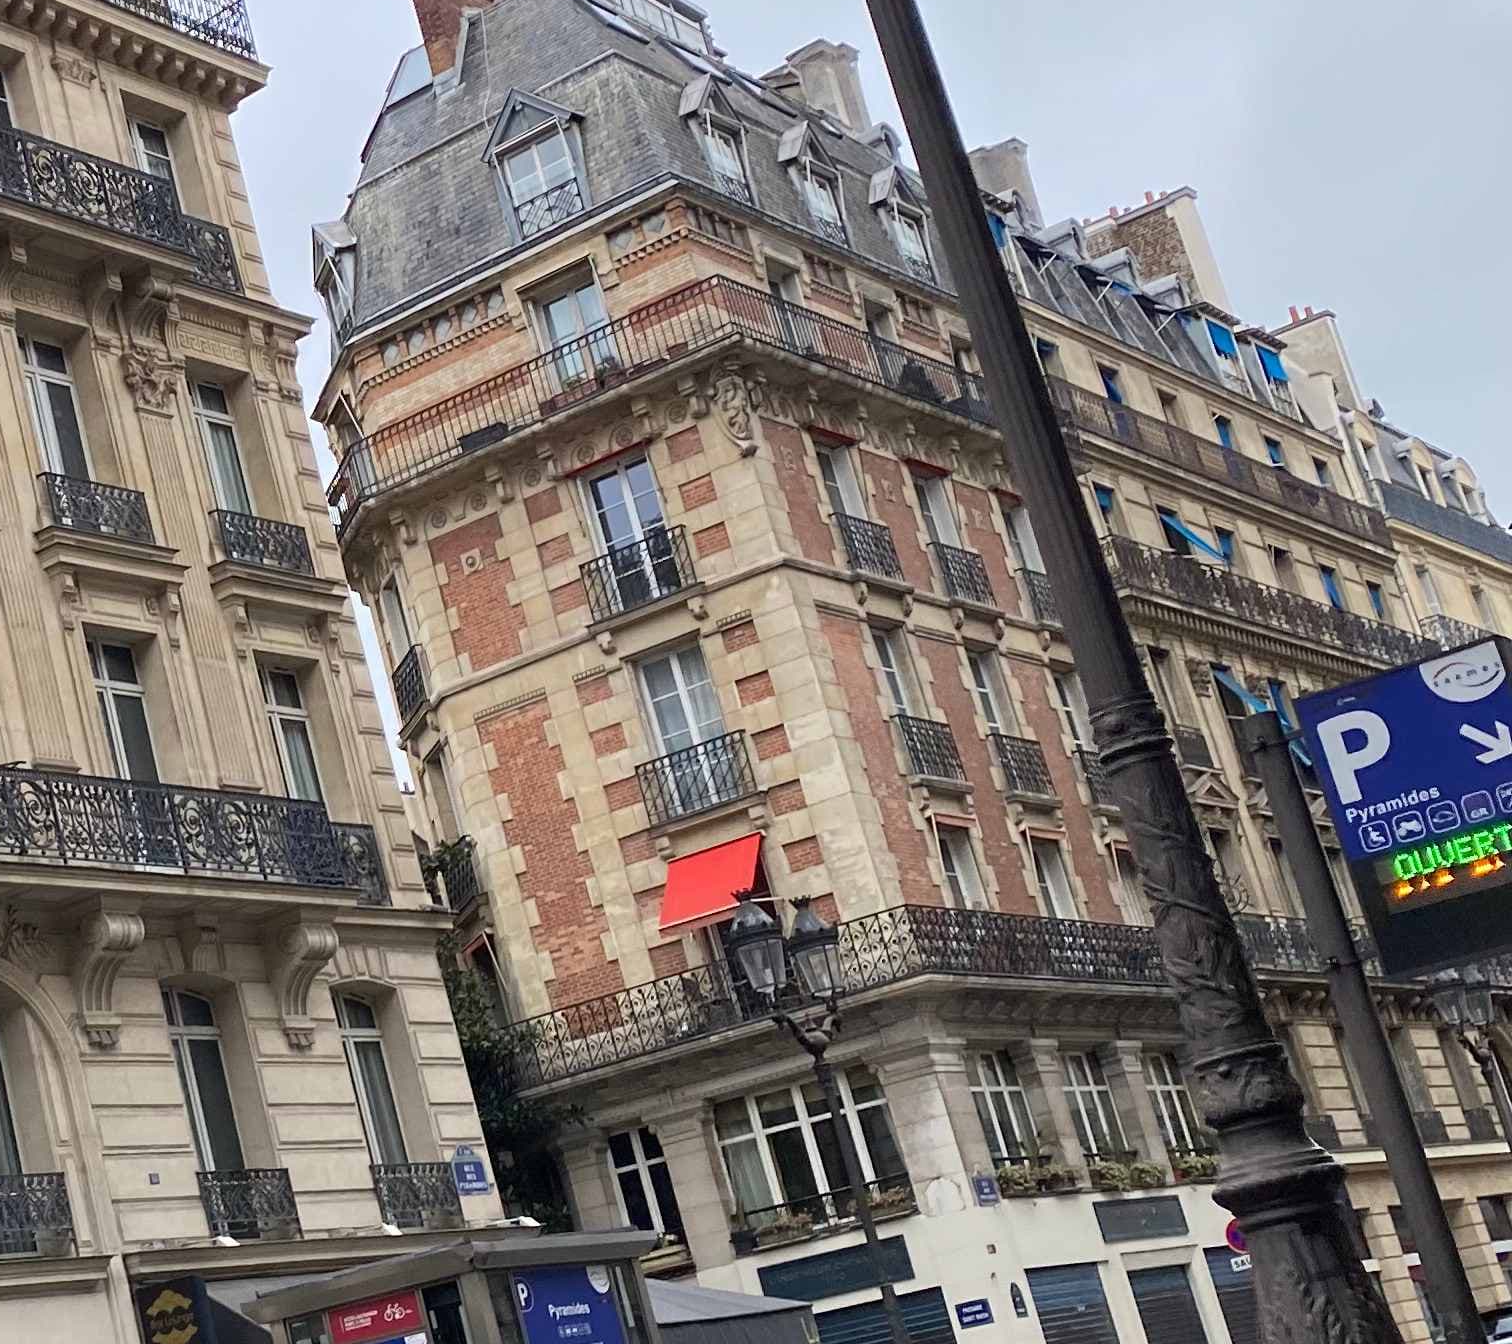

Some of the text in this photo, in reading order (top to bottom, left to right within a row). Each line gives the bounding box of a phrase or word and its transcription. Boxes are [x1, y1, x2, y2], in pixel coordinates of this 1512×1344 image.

[1317, 710, 1390, 805] P
[1345, 786, 1441, 824] Pyramides
[1393, 822, 1512, 882] OUVERT
[517, 1283, 529, 1306] P
[548, 1302, 591, 1320] Pyramides
